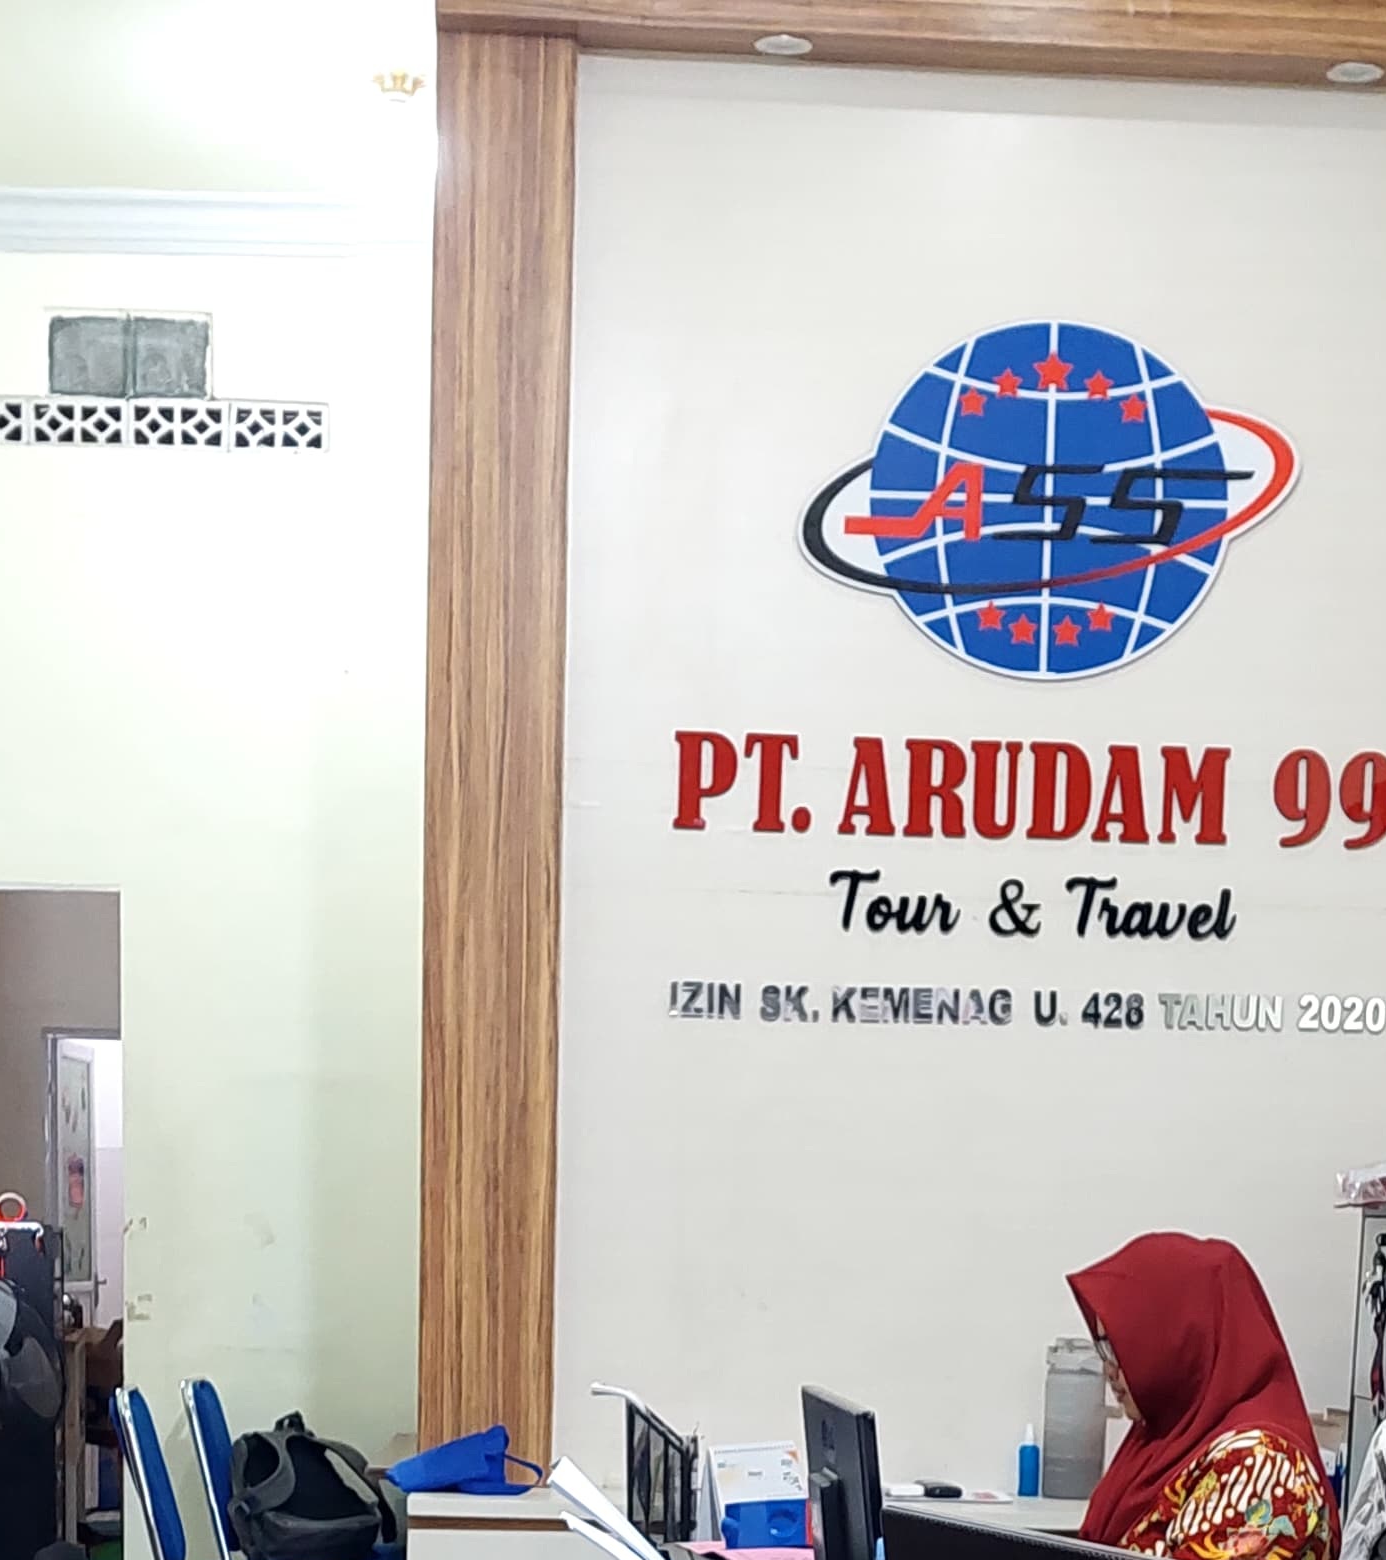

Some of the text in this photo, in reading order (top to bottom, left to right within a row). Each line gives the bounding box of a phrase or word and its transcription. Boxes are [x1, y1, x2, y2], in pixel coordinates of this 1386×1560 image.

[672, 730, 811, 834] PT.
[838, 736, 1232, 846] ARUDAM
[829, 869, 1236, 941] Tour & Travel
[669, 980, 742, 1020] IZIN
[759, 984, 819, 1025] SK.
[830, 986, 1013, 1027] KEMENAG
[1033, 990, 1068, 1028] U.
[1081, 990, 1145, 1030] 428
[1158, 991, 1283, 1032] TAHUN
